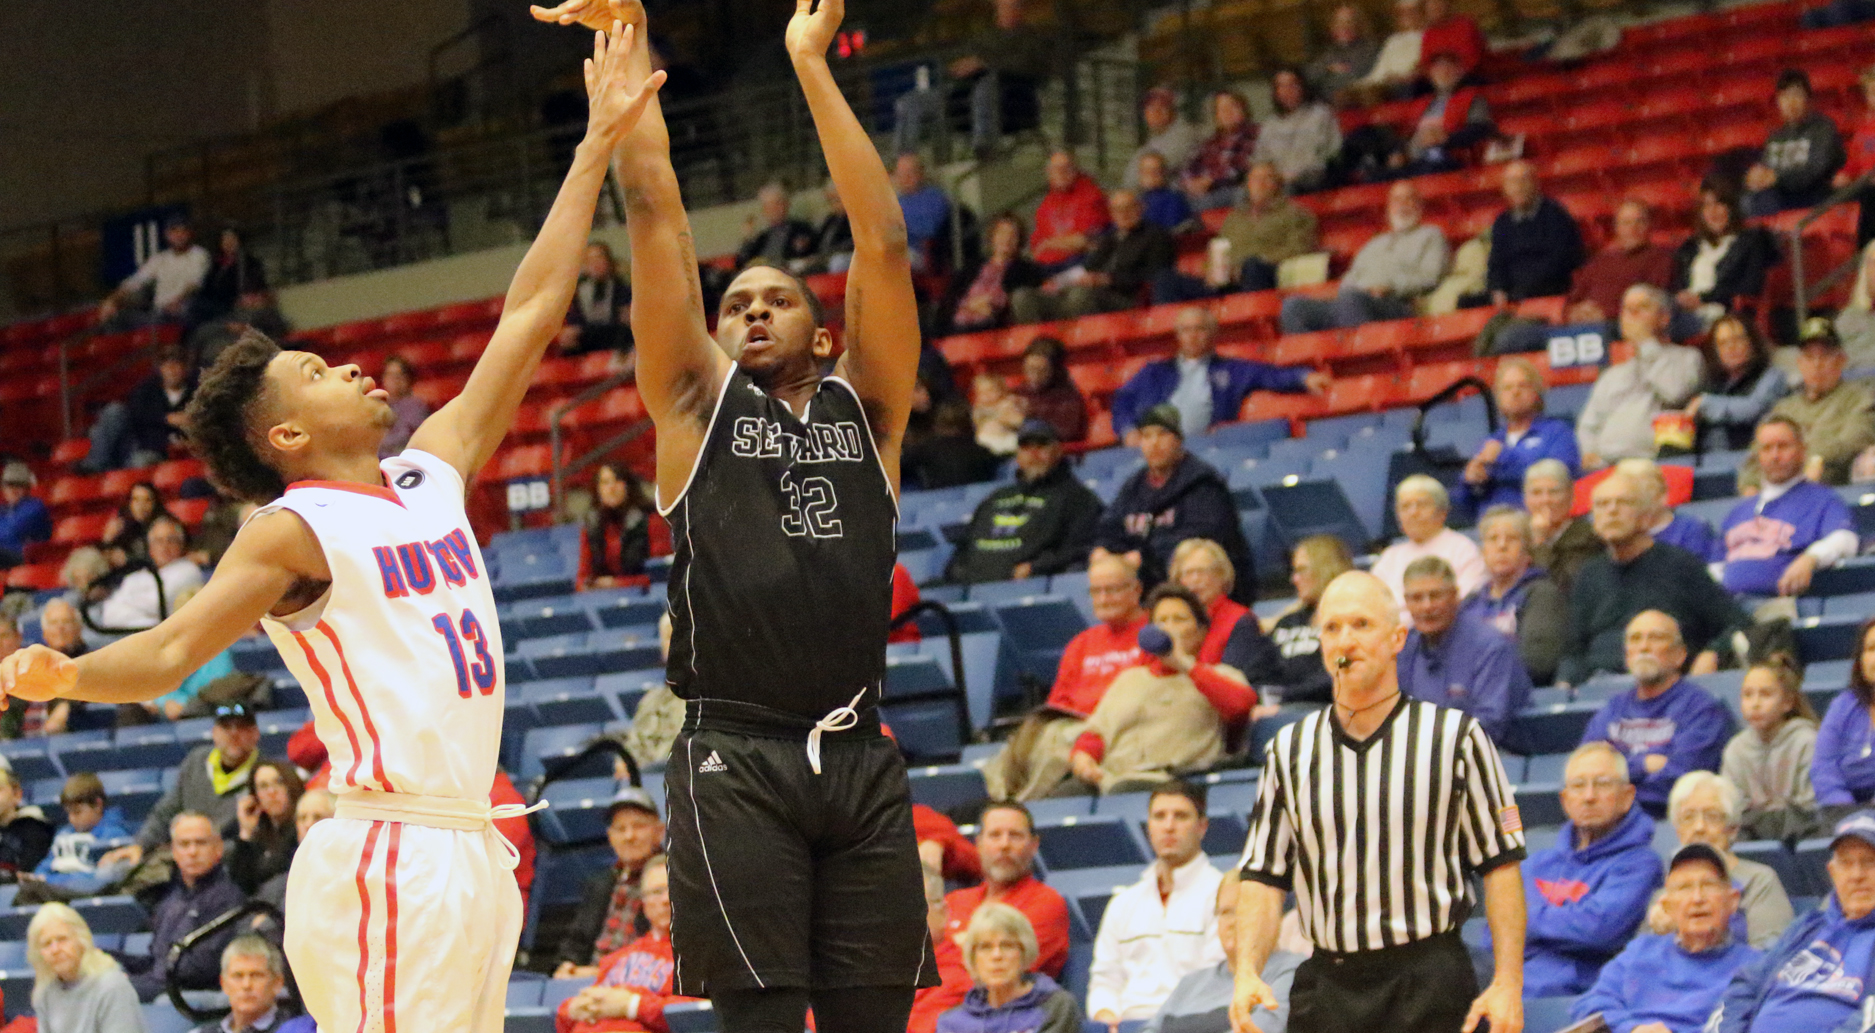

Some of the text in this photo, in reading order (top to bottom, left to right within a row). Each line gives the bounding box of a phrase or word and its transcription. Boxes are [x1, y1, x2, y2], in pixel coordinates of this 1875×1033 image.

[1549, 332, 1604, 367] BB
[507, 481, 550, 511] BB
[780, 471, 844, 539] 32
[430, 607, 497, 700] 13
[698, 763, 728, 774] adidas
